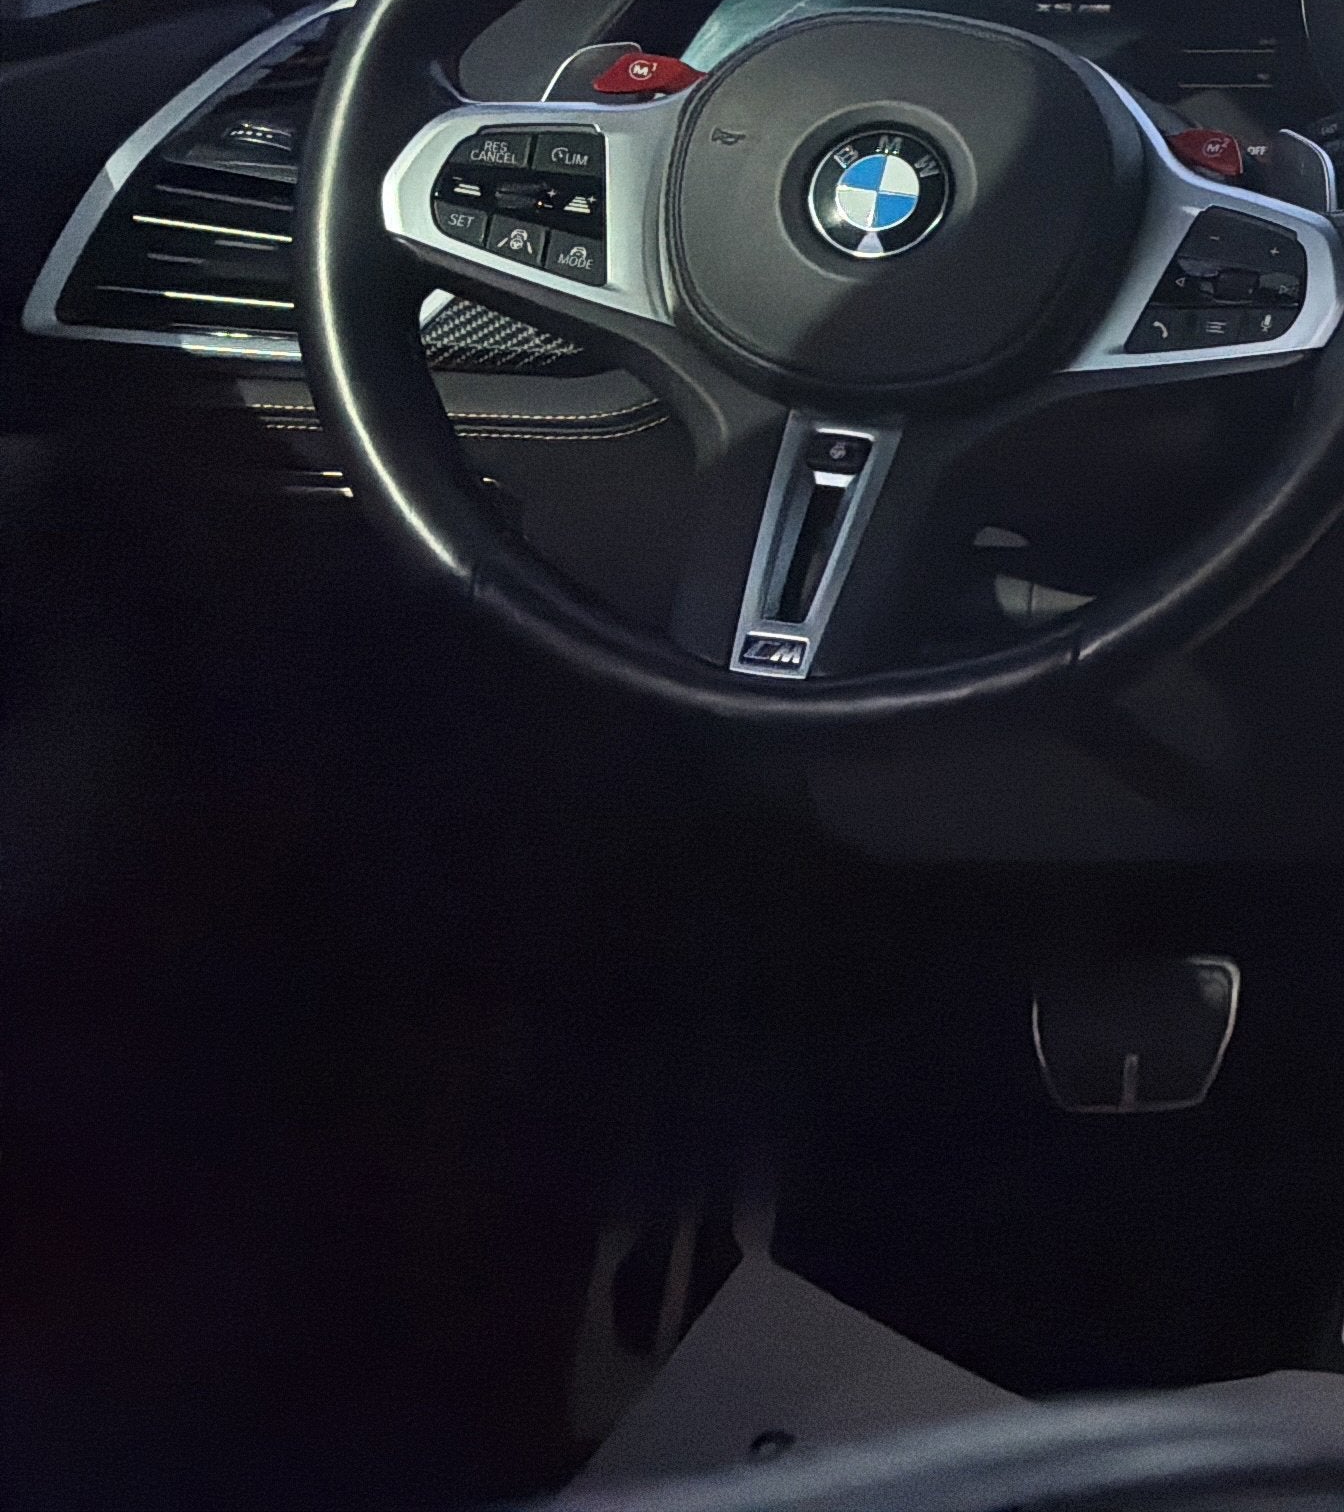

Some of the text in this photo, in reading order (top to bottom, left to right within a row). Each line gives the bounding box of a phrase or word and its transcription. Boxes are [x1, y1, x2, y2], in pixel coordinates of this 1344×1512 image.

[484, 140, 508, 153] RES
[470, 150, 517, 164] CANCEL
[564, 154, 589, 167] LIM
[834, 134, 940, 179] BMW
[448, 214, 473, 229] SET
[557, 251, 594, 271] MODE
